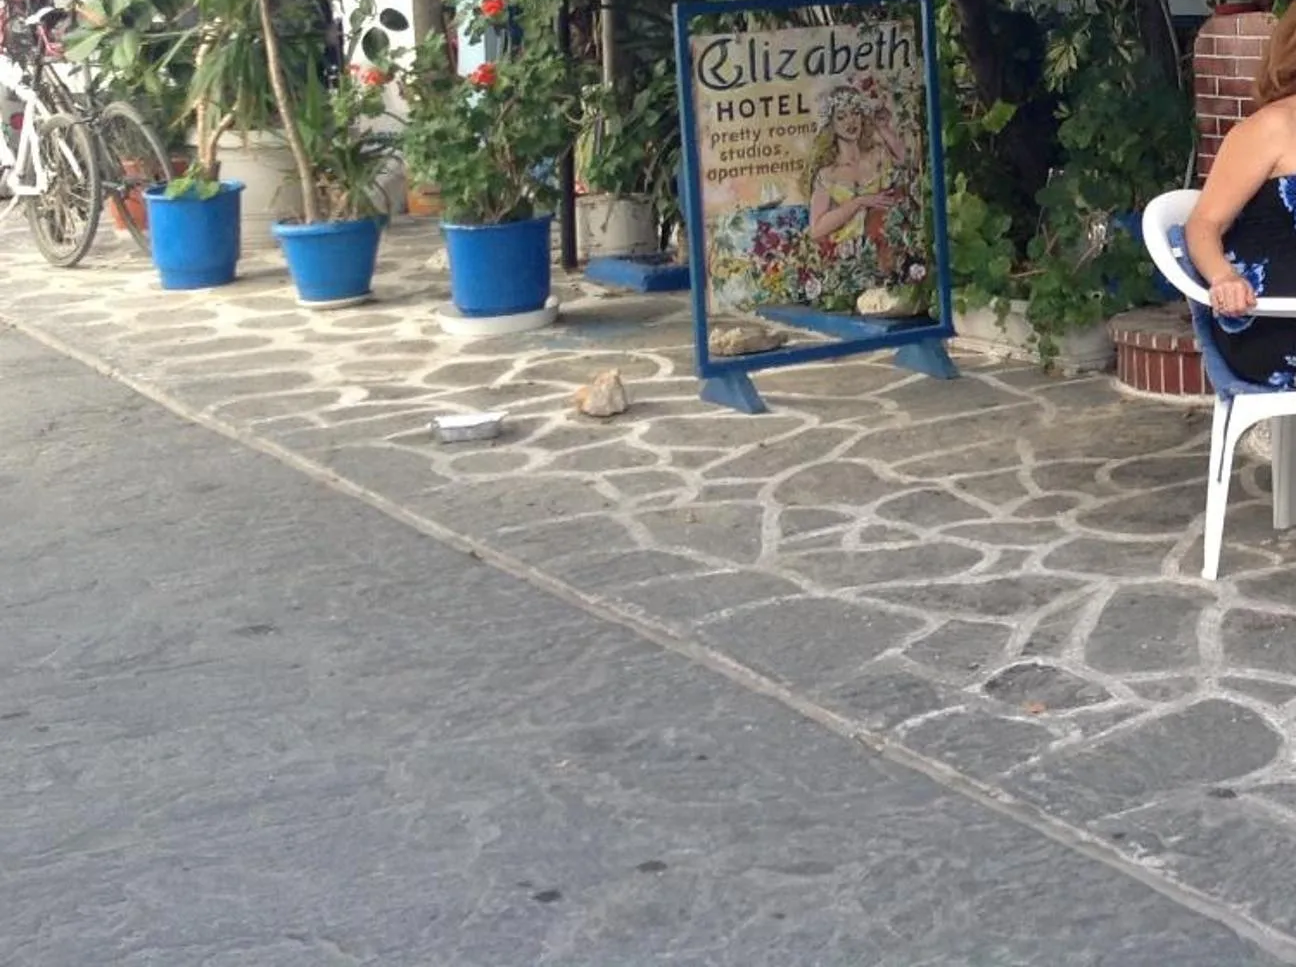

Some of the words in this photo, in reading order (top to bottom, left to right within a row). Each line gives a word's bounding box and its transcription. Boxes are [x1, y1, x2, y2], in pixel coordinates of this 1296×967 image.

[697, 26, 911, 91] Elizabeth
[716, 93, 811, 122] HOTEL
[711, 127, 761, 149] pretty
[769, 122, 818, 138] rooms
[706, 158, 805, 184] apartments
